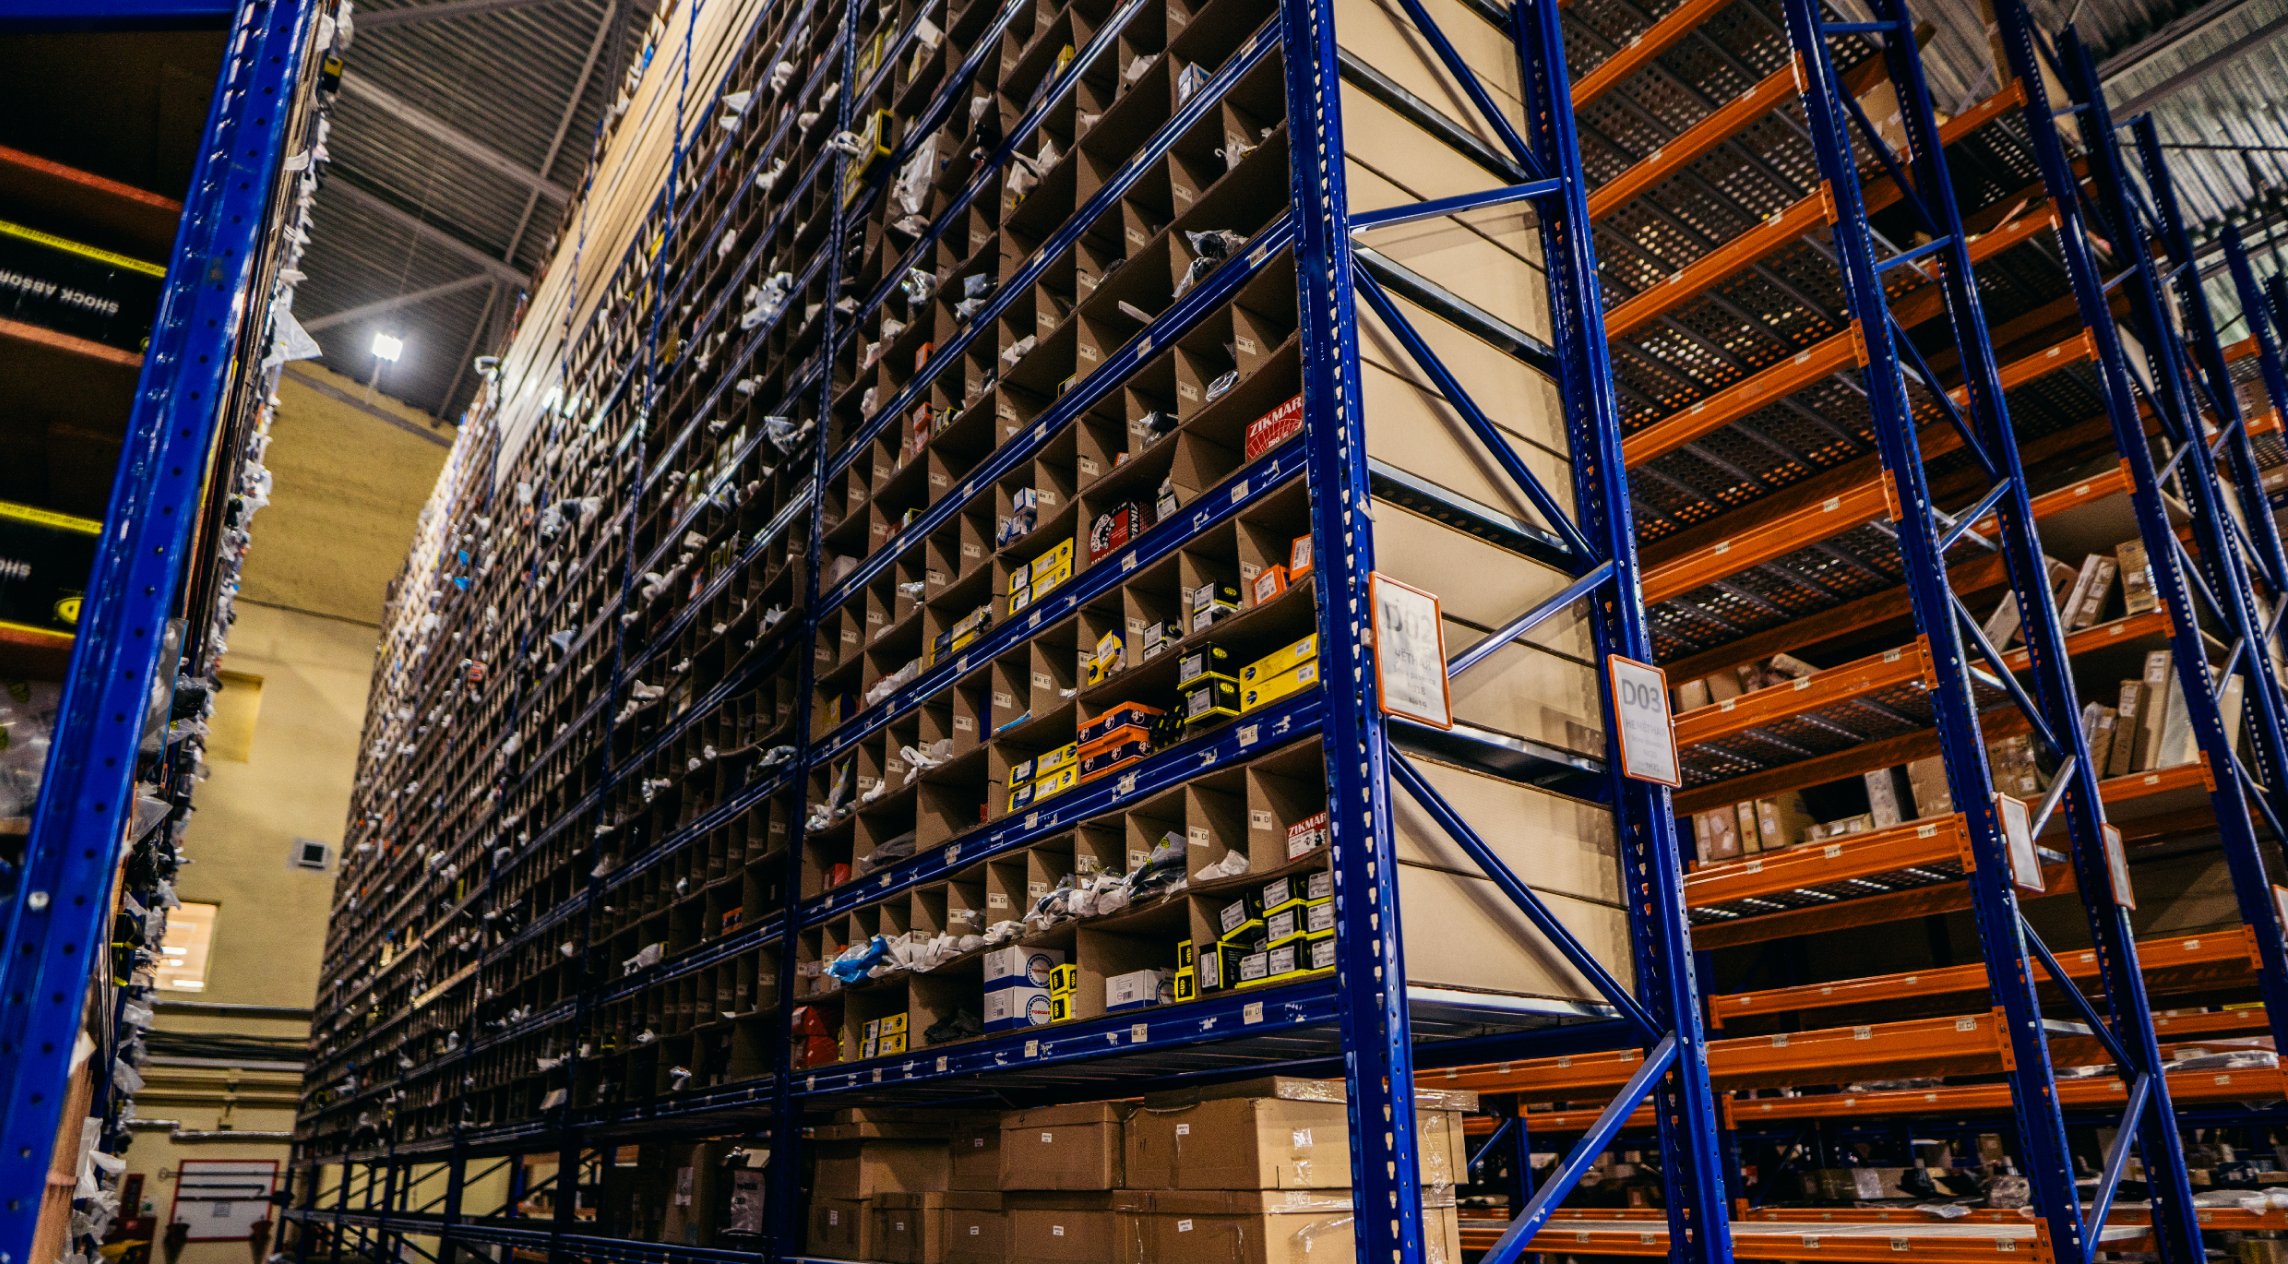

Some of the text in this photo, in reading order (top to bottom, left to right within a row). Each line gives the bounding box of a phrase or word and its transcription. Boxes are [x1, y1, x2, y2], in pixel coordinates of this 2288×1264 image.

[59, 287, 120, 316] SHOCK
[1249, 396, 1302, 438] ZIKMAR
[1384, 601, 1433, 641] D02
[1621, 678, 1662, 713] D03
[1288, 812, 1327, 837] ZIKMAR
